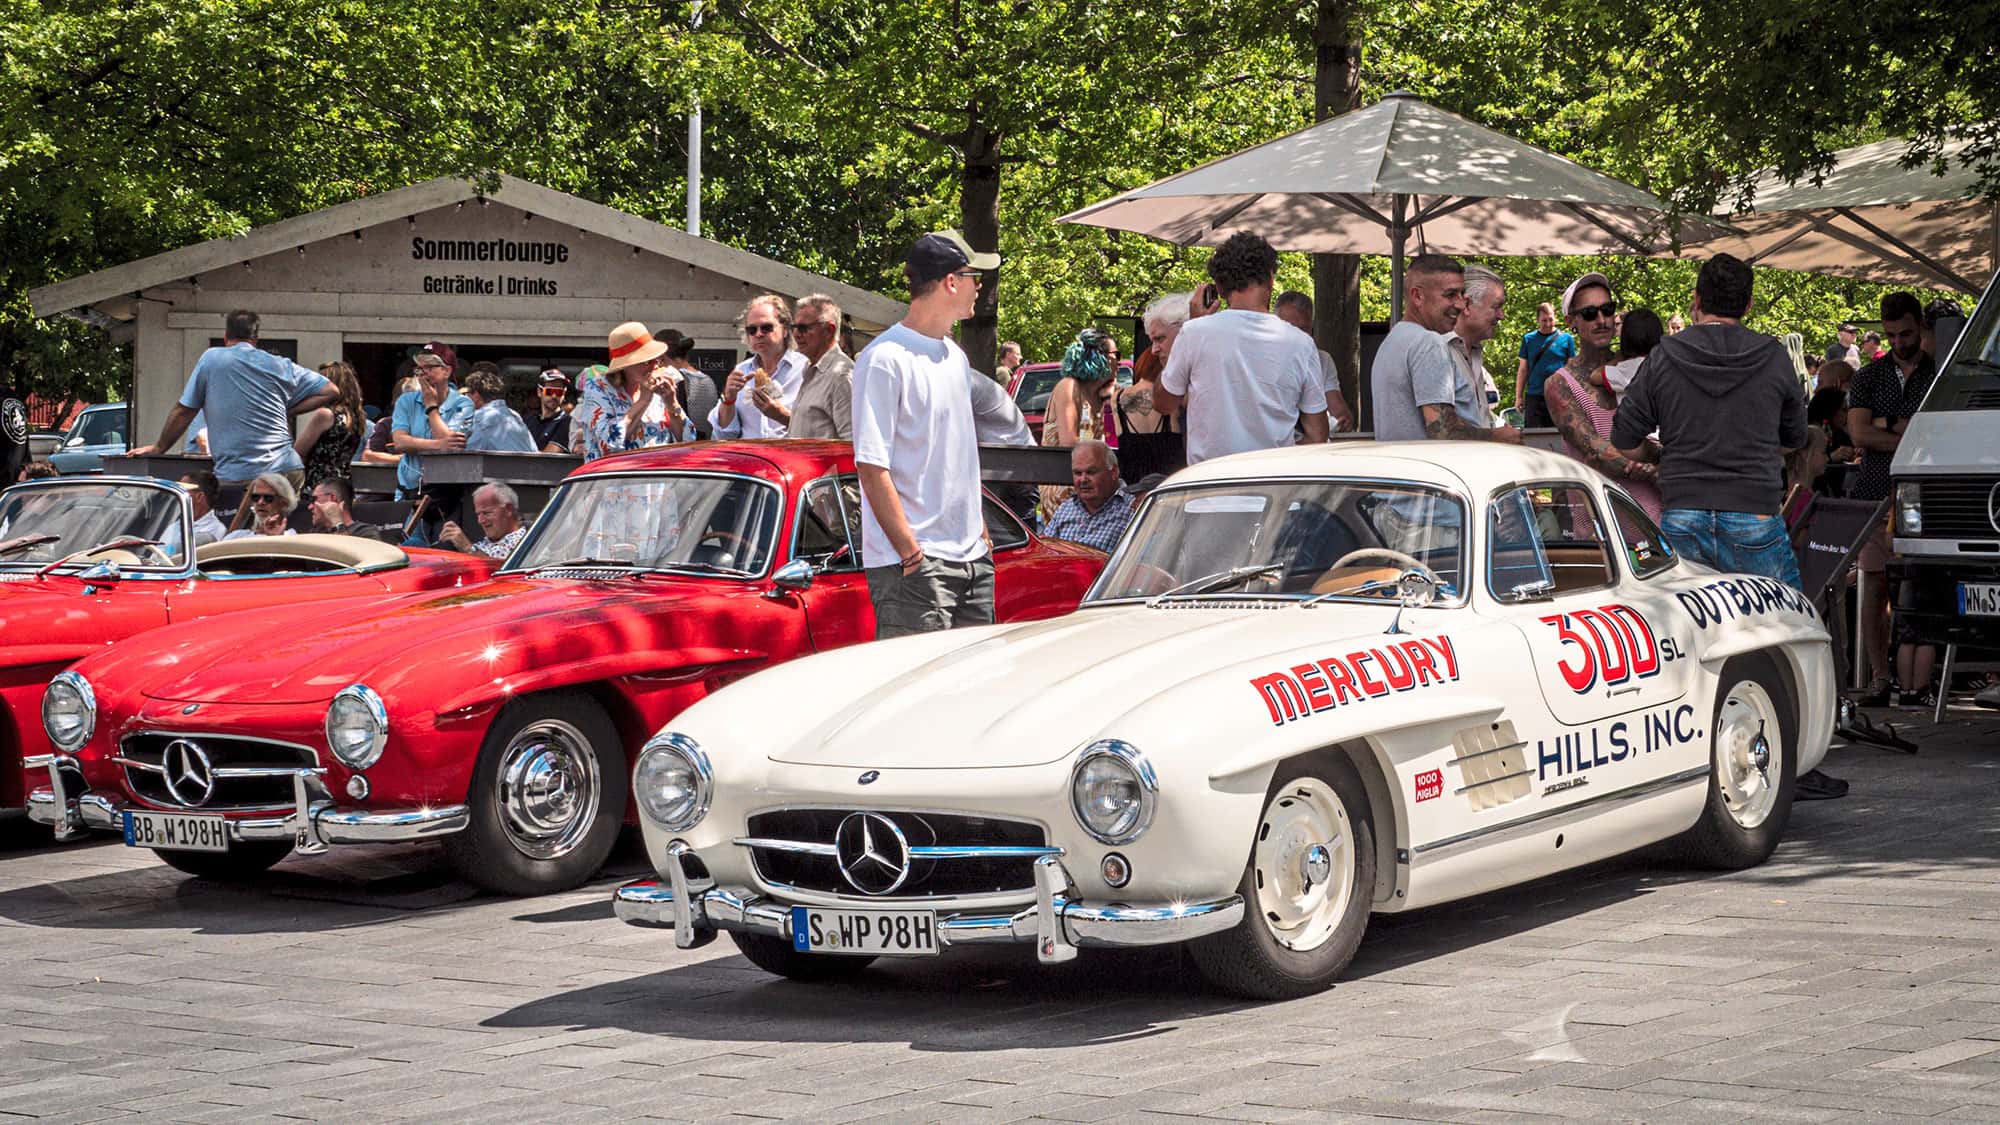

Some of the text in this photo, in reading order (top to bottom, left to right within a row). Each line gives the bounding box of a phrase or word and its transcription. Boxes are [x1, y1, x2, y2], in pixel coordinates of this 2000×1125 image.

[412, 237, 569, 264] Sommerlounge
[424, 275, 494, 294] Getränke
[507, 277, 557, 295] Drinks
[1660, 637, 1686, 662] SL
[1249, 634, 1460, 727] MERCURY
[1537, 704, 1704, 781] HILLS, INC.
[1417, 772, 1437, 787] 1000
[133, 816, 155, 842] BB
[810, 913, 824, 946] S
[838, 915, 871, 947] WP
[878, 916, 932, 949] 98H
